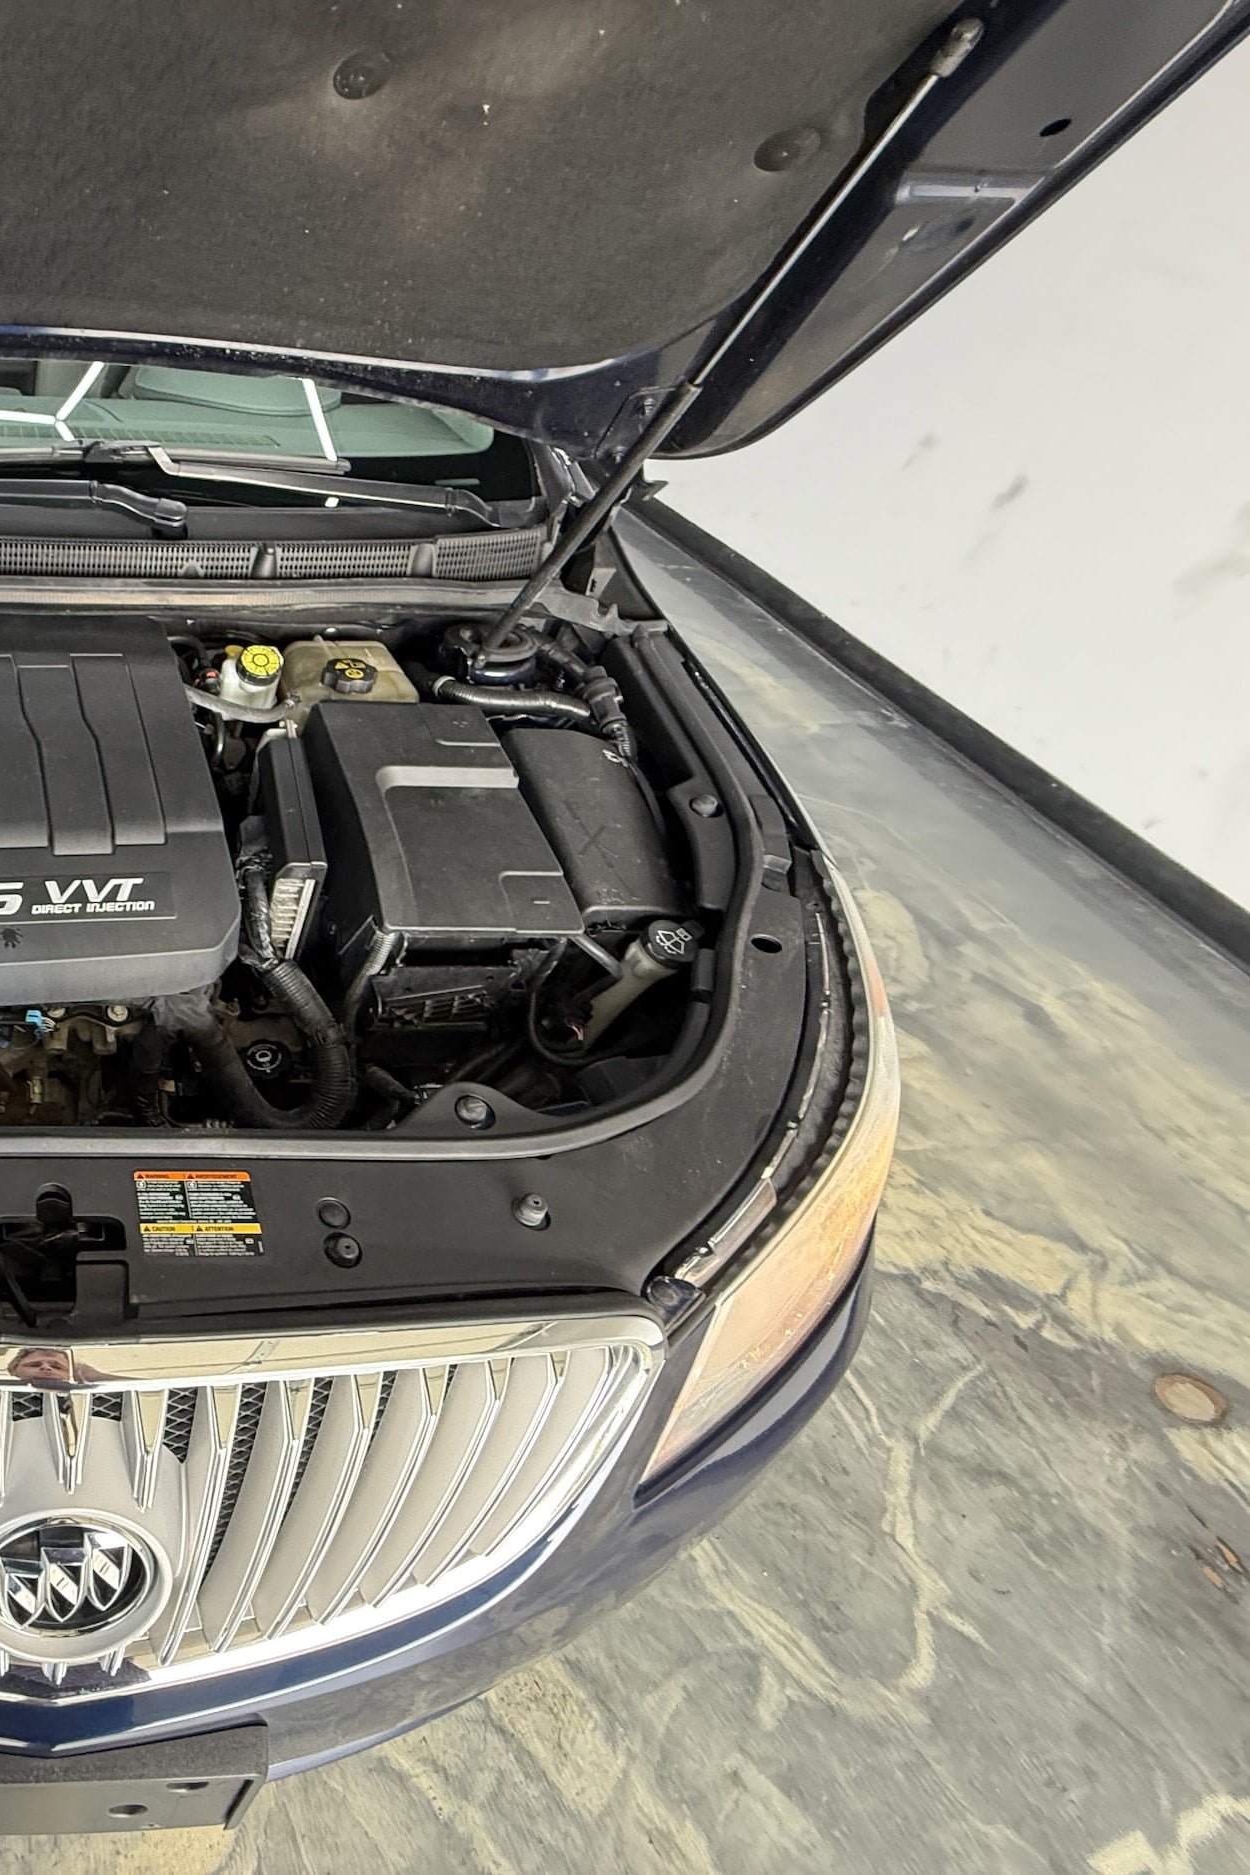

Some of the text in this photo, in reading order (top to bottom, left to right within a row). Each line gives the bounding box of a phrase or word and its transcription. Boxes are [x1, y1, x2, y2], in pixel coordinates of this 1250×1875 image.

[44, 877, 144, 904] VVT
[31, 900, 155, 915] DIRECT INJECTION
